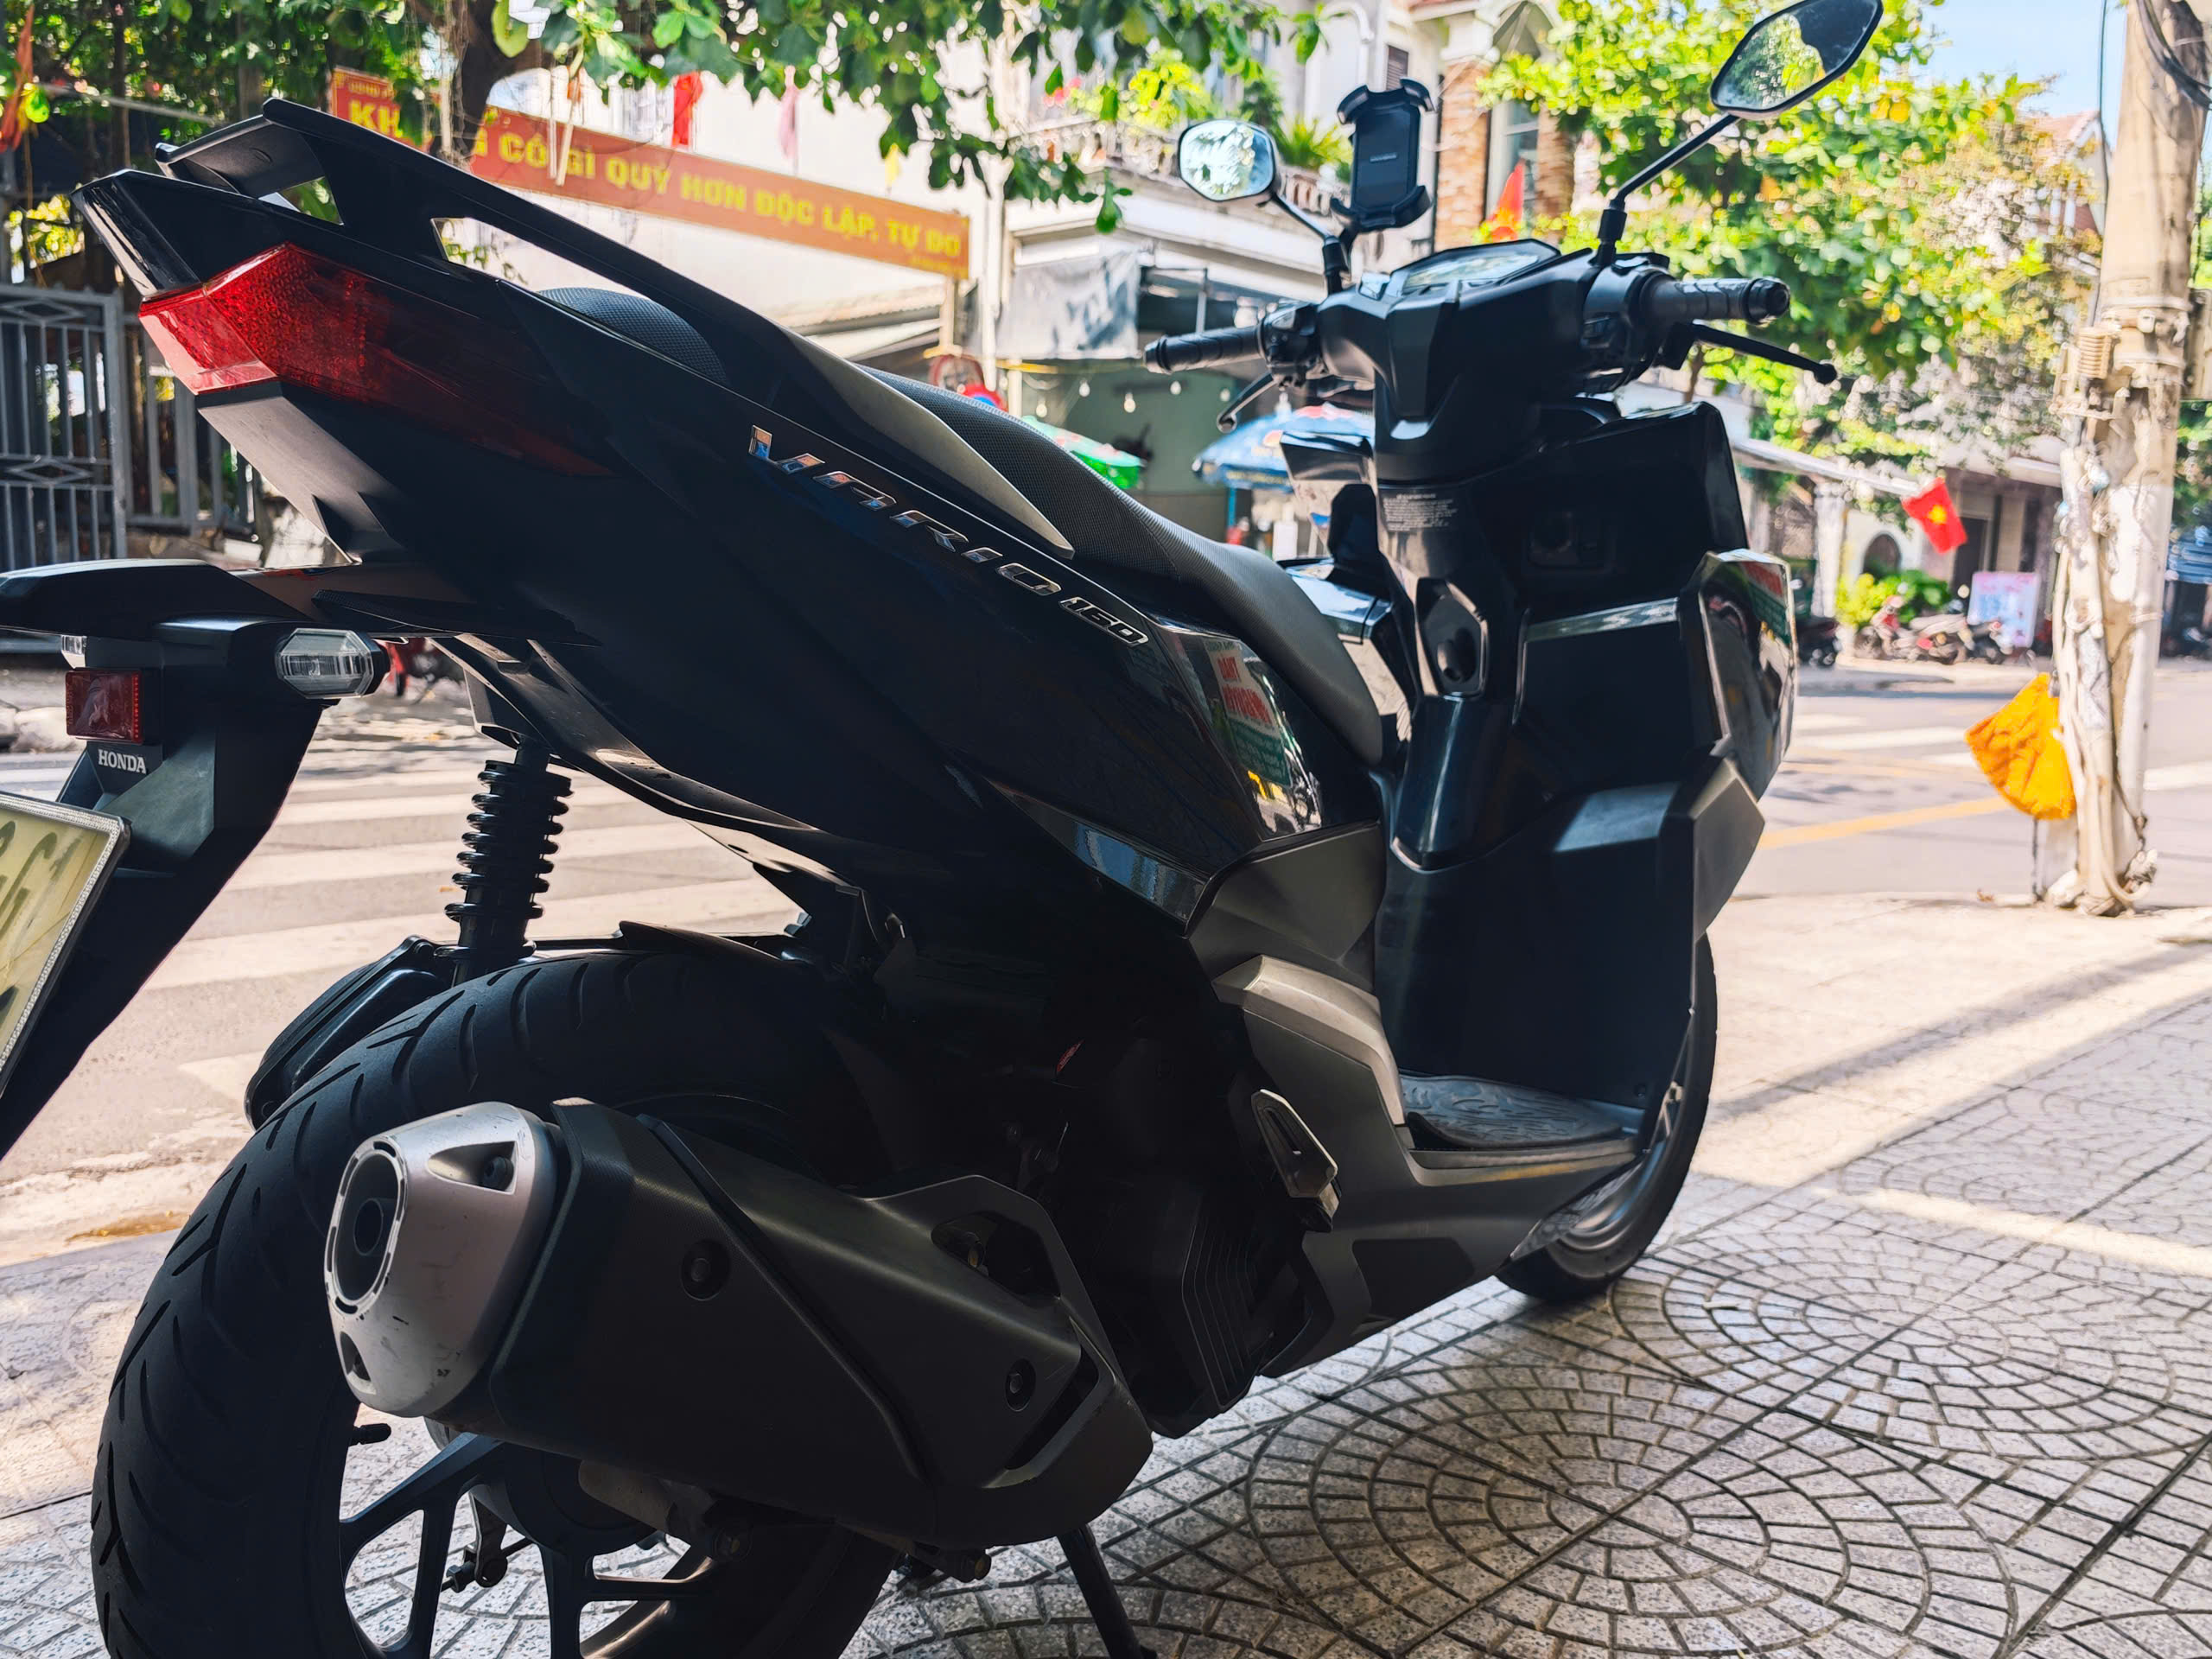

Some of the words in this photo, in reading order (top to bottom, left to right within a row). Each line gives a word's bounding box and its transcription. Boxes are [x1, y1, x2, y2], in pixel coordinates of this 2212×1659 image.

[748, 425, 1062, 596] VARIO
[1059, 596, 1149, 647] 160
[99, 748, 147, 775] HONDA
